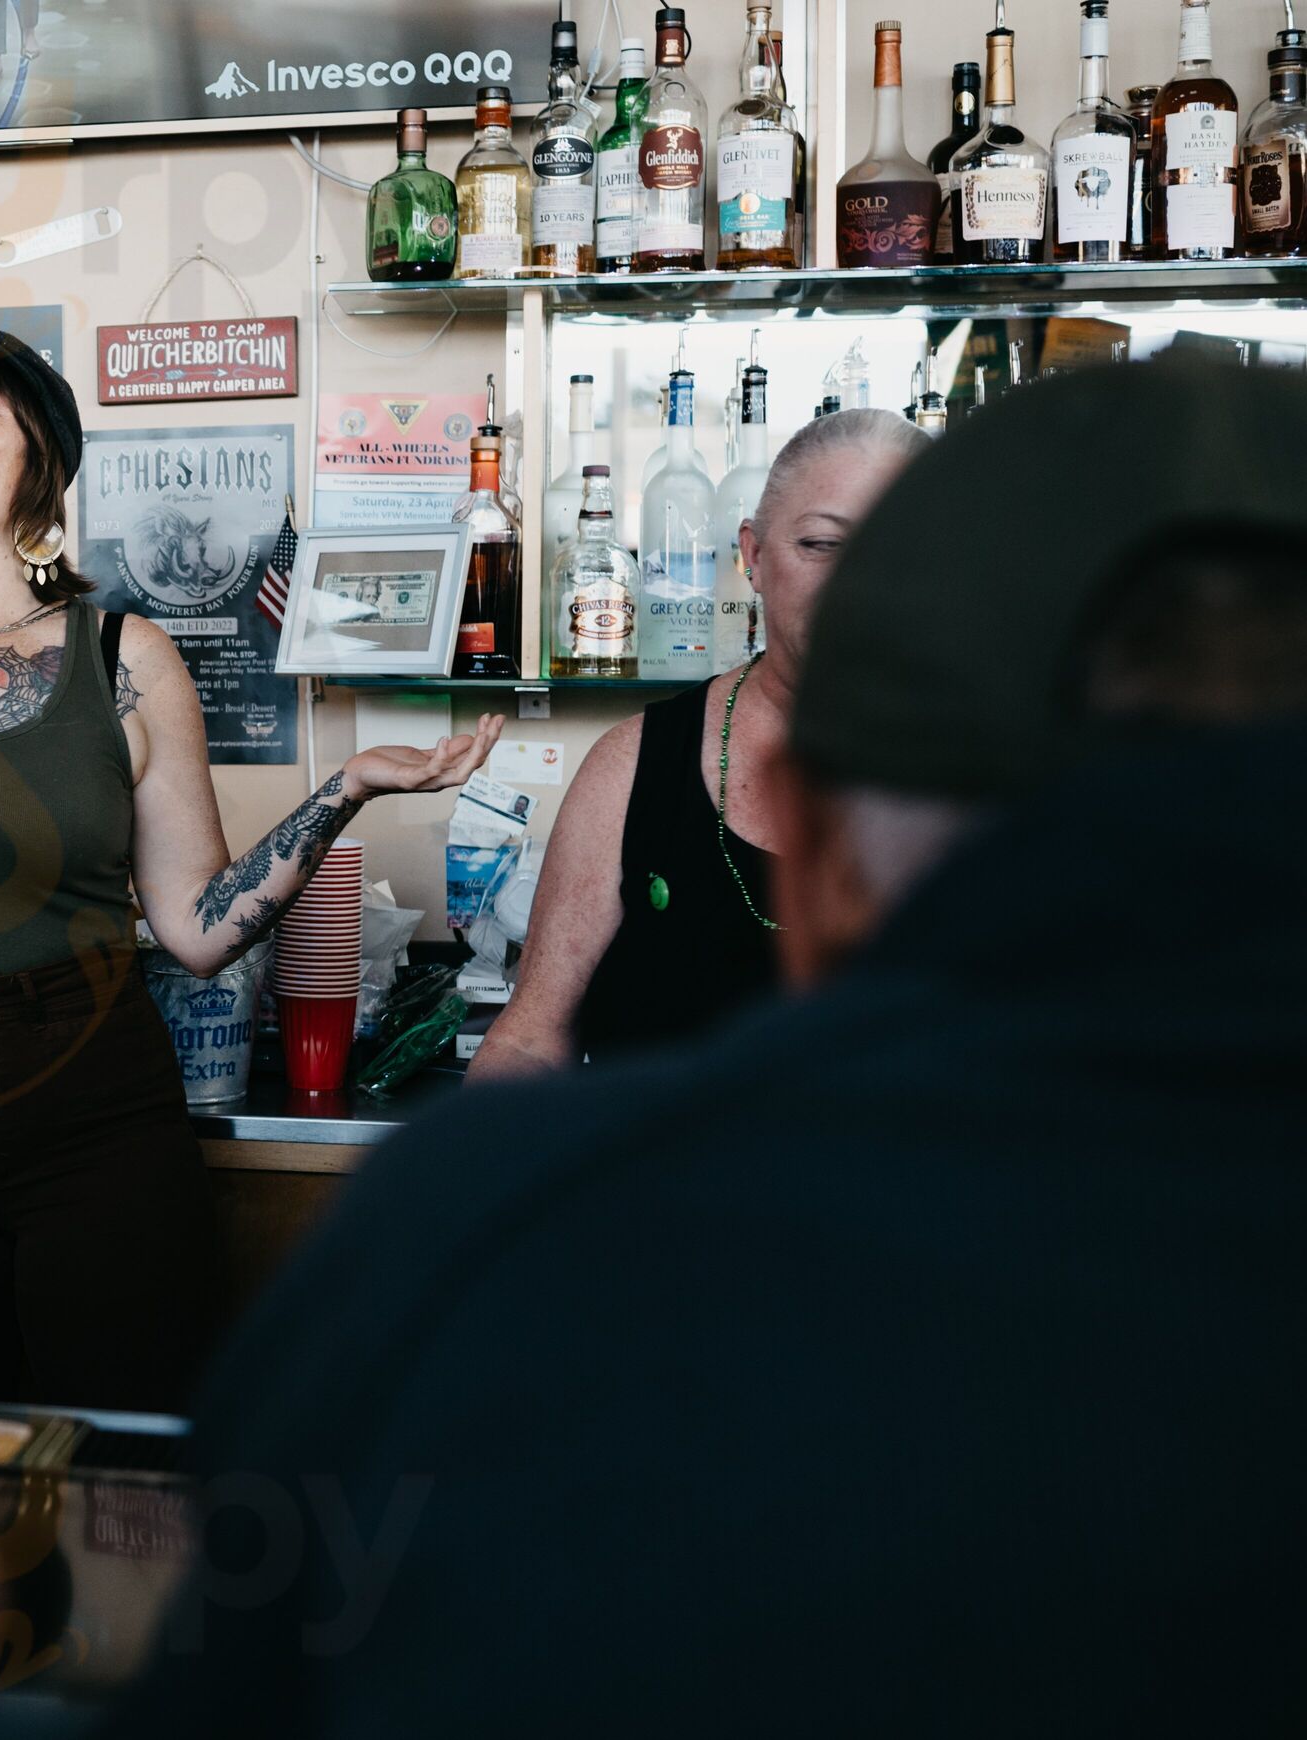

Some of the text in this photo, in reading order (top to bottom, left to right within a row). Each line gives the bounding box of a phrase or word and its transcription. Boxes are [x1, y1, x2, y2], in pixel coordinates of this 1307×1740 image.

[267, 49, 514, 92] Invesco QQQ
[1191, 132, 1222, 140] BASIL
[1184, 141, 1229, 149] HAYDEN
[533, 151, 593, 166] GLENGOYNE
[645, 148, 699, 167] Glenfiddich
[722, 149, 780, 164] GLENLIVET
[1063, 152, 1124, 164] SKREWBALL
[976, 190, 1037, 204] Hennessy
[844, 196, 889, 211] GOLD
[539, 213, 585, 223] 10 YEARS
[127, 323, 266, 342] WELCOME TO CAMP
[107, 335, 287, 378] QUITCHERBITCHIN
[108, 377, 286, 398] A CERTIFIED HAPPY CAMPER AREA
[359, 443, 450, 453] ALL WHEELS
[325, 454, 393, 464] VETERANS
[99, 445, 273, 499] EPHESIANS
[352, 496, 453, 509] Saturday, 23 April
[404, 511, 445, 519] Memorial
[94, 520, 120, 531] 1973
[116, 544, 260, 616] ANNUAL MONTEREY BAY POKER RUN
[571, 600, 635, 615] CHIVAS REGAL
[650, 602, 683, 616] GREY
[166, 620, 233, 632] 14th ETD 2022
[601, 615, 611, 625] 12
[182, 639, 202, 648] 9am
[203, 638, 223, 648] until
[226, 638, 250, 648] 11am
[230, 659, 251, 668] Legion
[211, 668, 231, 676] Legion
[194, 679, 240, 690] tarts at 1pm
[225, 703, 246, 713] Bread
[251, 703, 277, 713] Dessert
[179, 1053, 237, 1081] Extra
